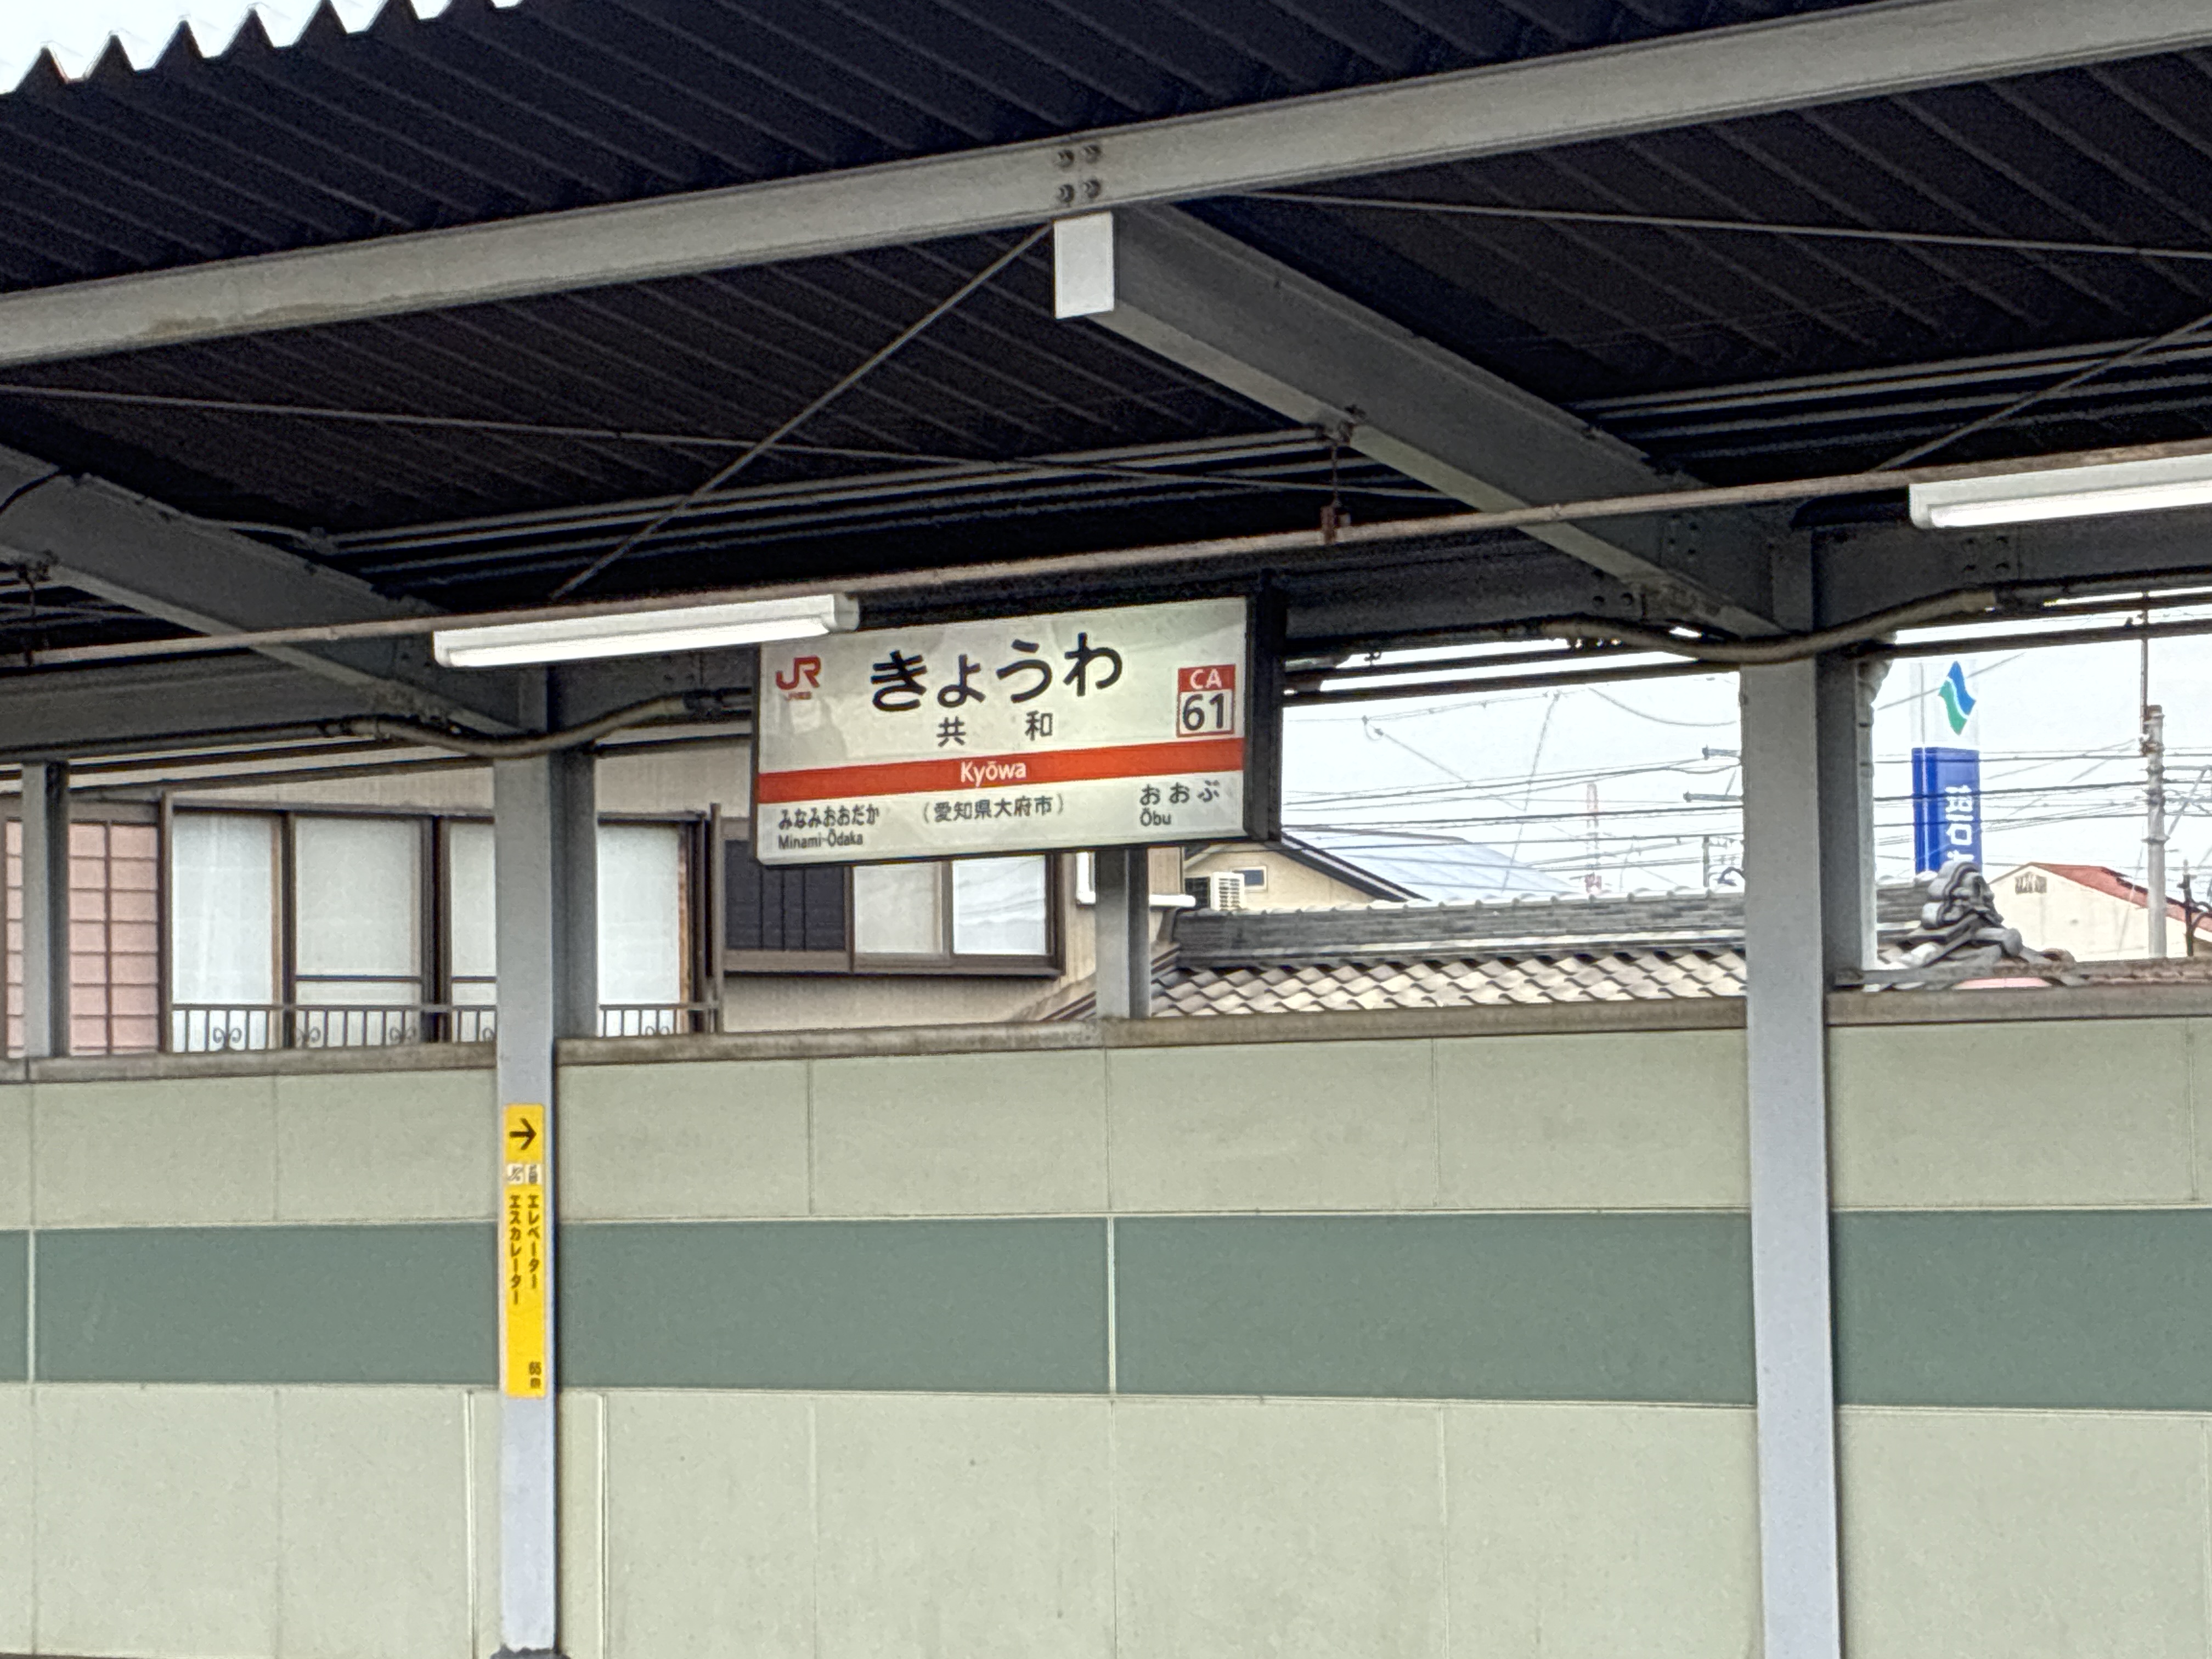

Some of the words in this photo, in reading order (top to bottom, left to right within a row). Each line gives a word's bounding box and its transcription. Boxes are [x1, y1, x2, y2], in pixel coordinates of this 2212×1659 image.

[775, 655, 821, 690] JR
[870, 631, 1122, 712] きょうわ
[1189, 668, 1222, 690] CA
[937, 711, 1052, 747] 共和
[1182, 693, 1224, 731] 61
[961, 760, 1026, 787] Kyōwa
[1139, 780, 1220, 805] おおぶ
[778, 803, 880, 830] みなみおおだか
[1139, 807, 1171, 827] Ōbu
[509, 1194, 522, 1305] エスカレーター
[527, 1194, 540, 1289] エレベーター
